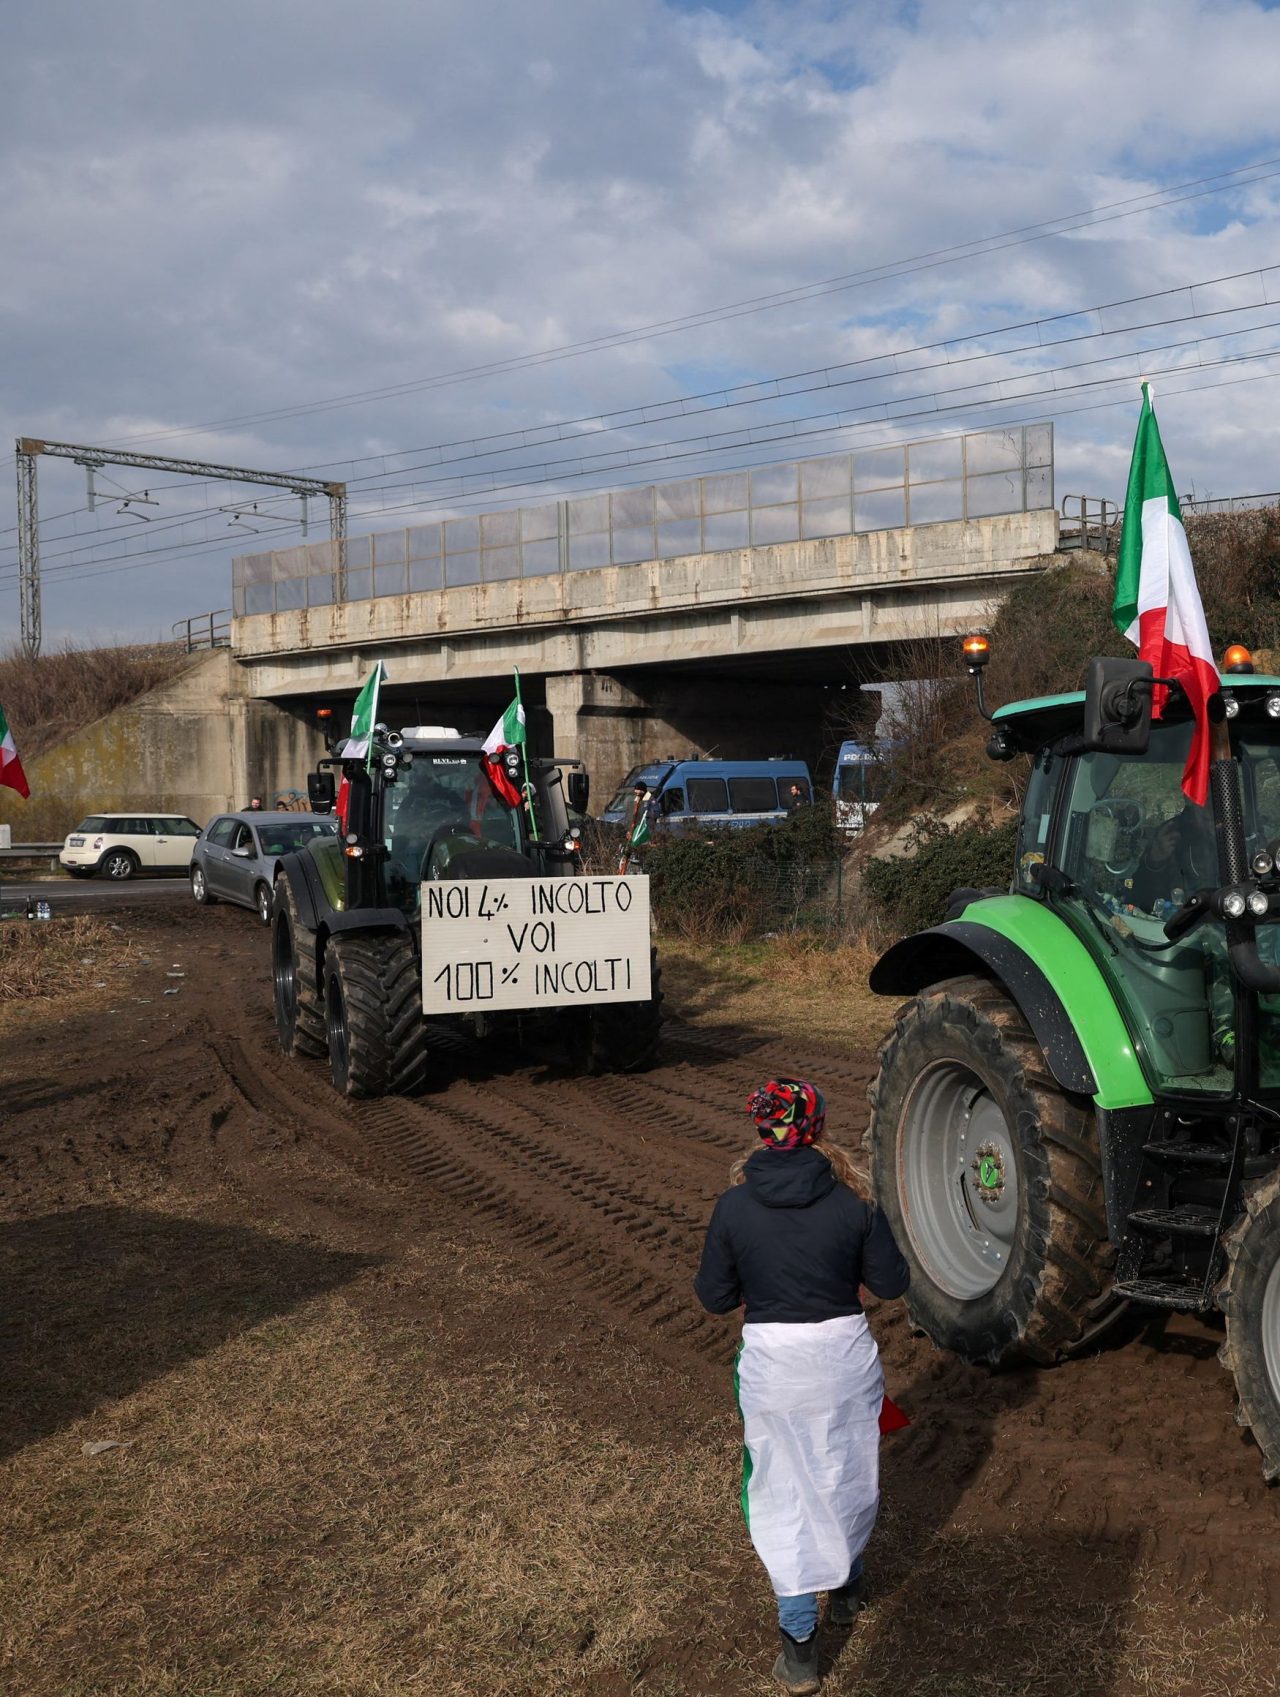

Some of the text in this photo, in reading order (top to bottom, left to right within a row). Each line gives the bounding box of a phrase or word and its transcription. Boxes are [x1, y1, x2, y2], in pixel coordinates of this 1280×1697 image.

[429, 881, 632, 921] NOI 4% INCOLTO
[507, 921, 556, 953] VOI
[434, 957, 631, 1001] 100% INCOLTI
